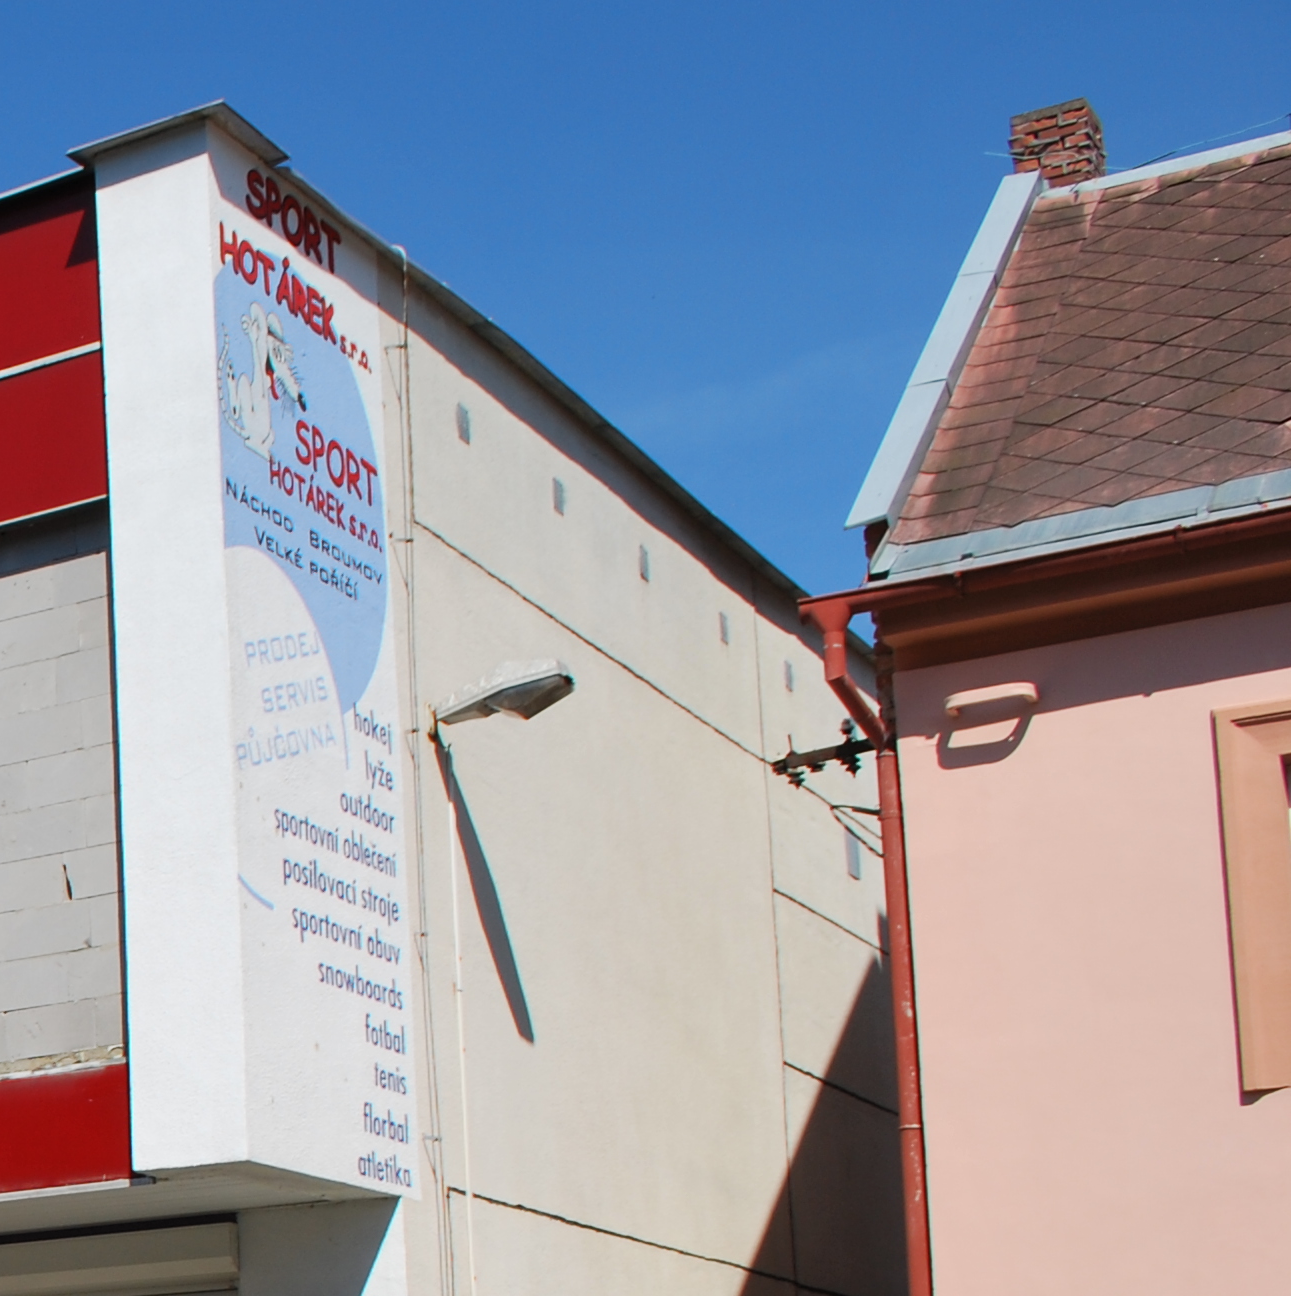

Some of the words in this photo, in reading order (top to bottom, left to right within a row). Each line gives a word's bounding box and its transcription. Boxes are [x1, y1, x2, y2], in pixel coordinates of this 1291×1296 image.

[245, 169, 341, 274] SPORT
[295, 419, 378, 507] SPORT
[270, 454, 346, 531] HOTÁREK
[225, 477, 294, 533] NÁCHOD
[309, 530, 383, 585] BROUMOV
[254, 525, 304, 569] VELKÉ
[308, 561, 359, 601] POŘÍČÍ
[244, 631, 320, 668] PRODEJ
[261, 674, 328, 714] SERVIS
[235, 722, 337, 770] PŮJČOVNA
[353, 701, 393, 755] hokej
[364, 749, 394, 791] lyže
[339, 792, 395, 834] outdoor
[274, 807, 340, 854] sportovní
[343, 829, 397, 879] oblečení
[282, 857, 357, 906] posilovací
[360, 886, 400, 927] stroje
[291, 907, 363, 951] sportovní
[367, 927, 401, 966] obuv
[318, 962, 403, 1010] snowboards
[364, 1014, 406, 1055] fotbal
[373, 1061, 406, 1095] tenis
[362, 1102, 409, 1144] florbal
[357, 1151, 412, 1188] atletika
